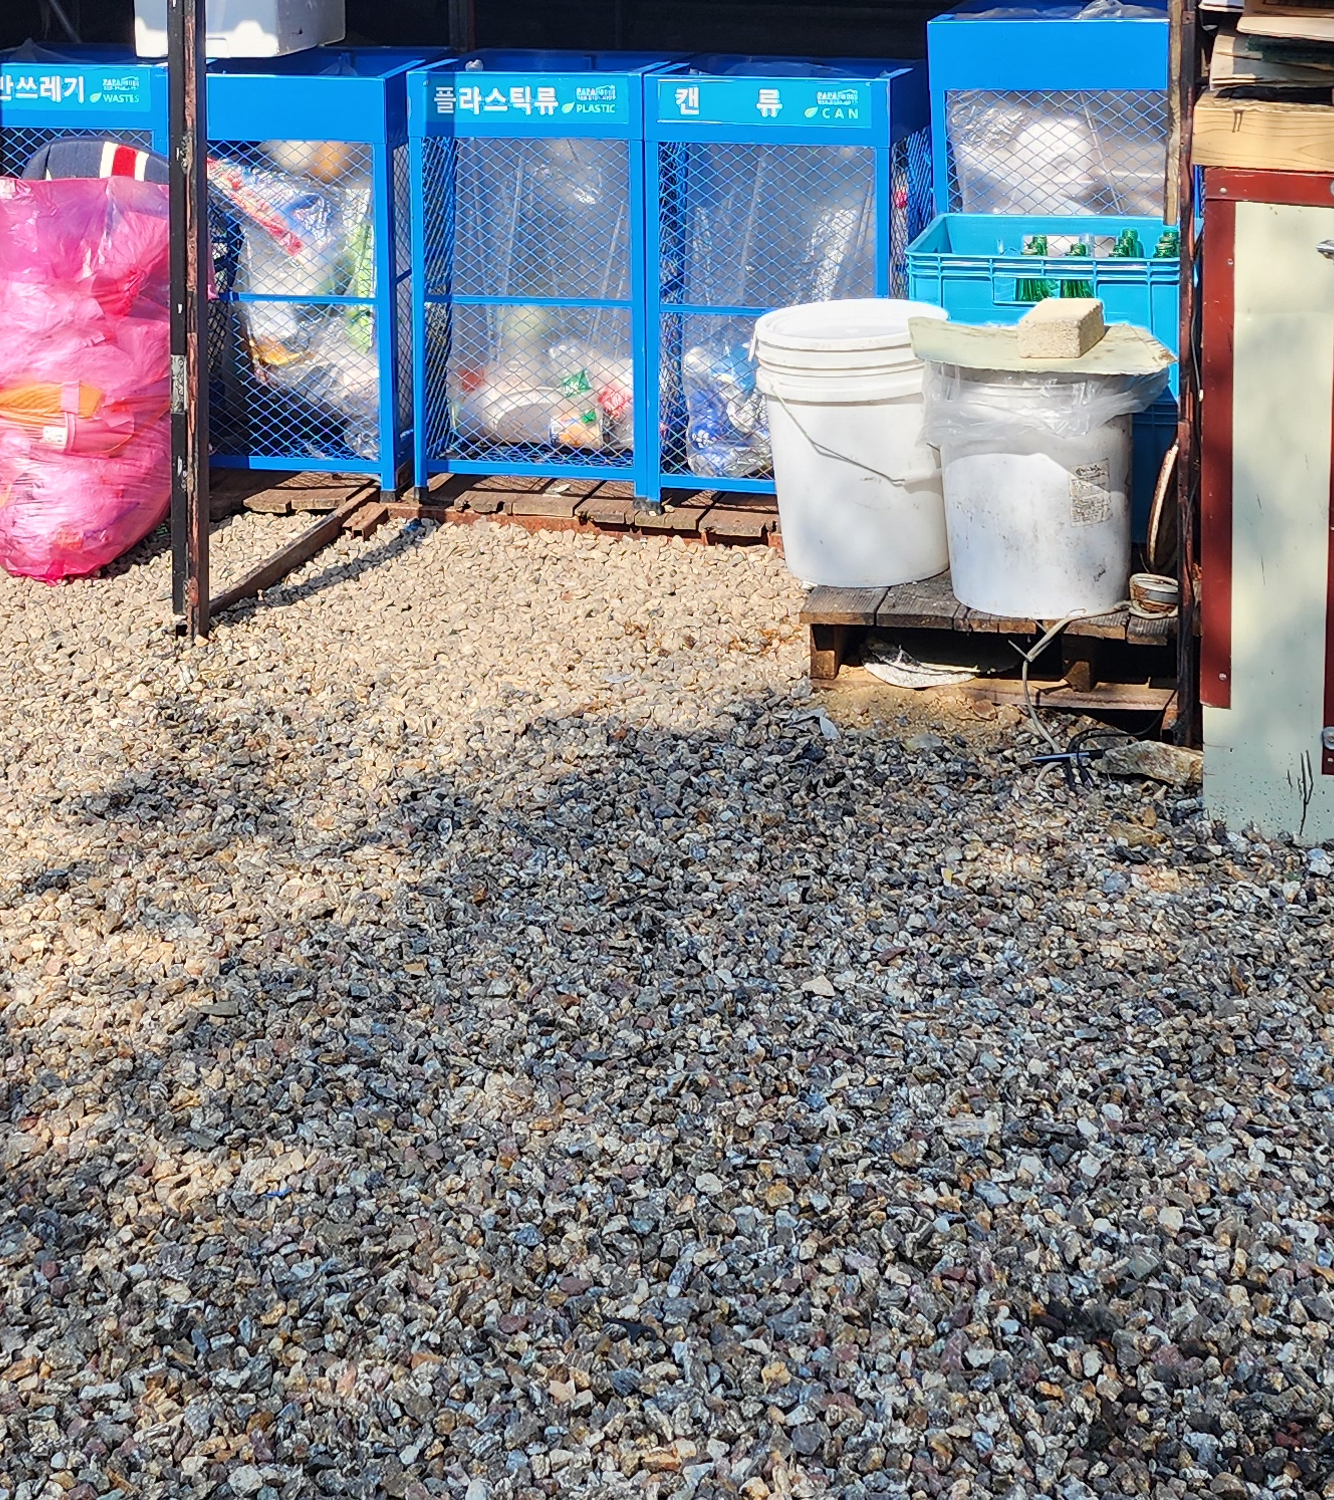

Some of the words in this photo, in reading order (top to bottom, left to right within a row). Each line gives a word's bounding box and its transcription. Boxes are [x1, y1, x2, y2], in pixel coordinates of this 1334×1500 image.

[103, 94, 140, 103] WASTES
[433, 85, 559, 116] 플라스틱류
[576, 103, 616, 113] PLASTIC
[822, 107, 859, 119] CAN
